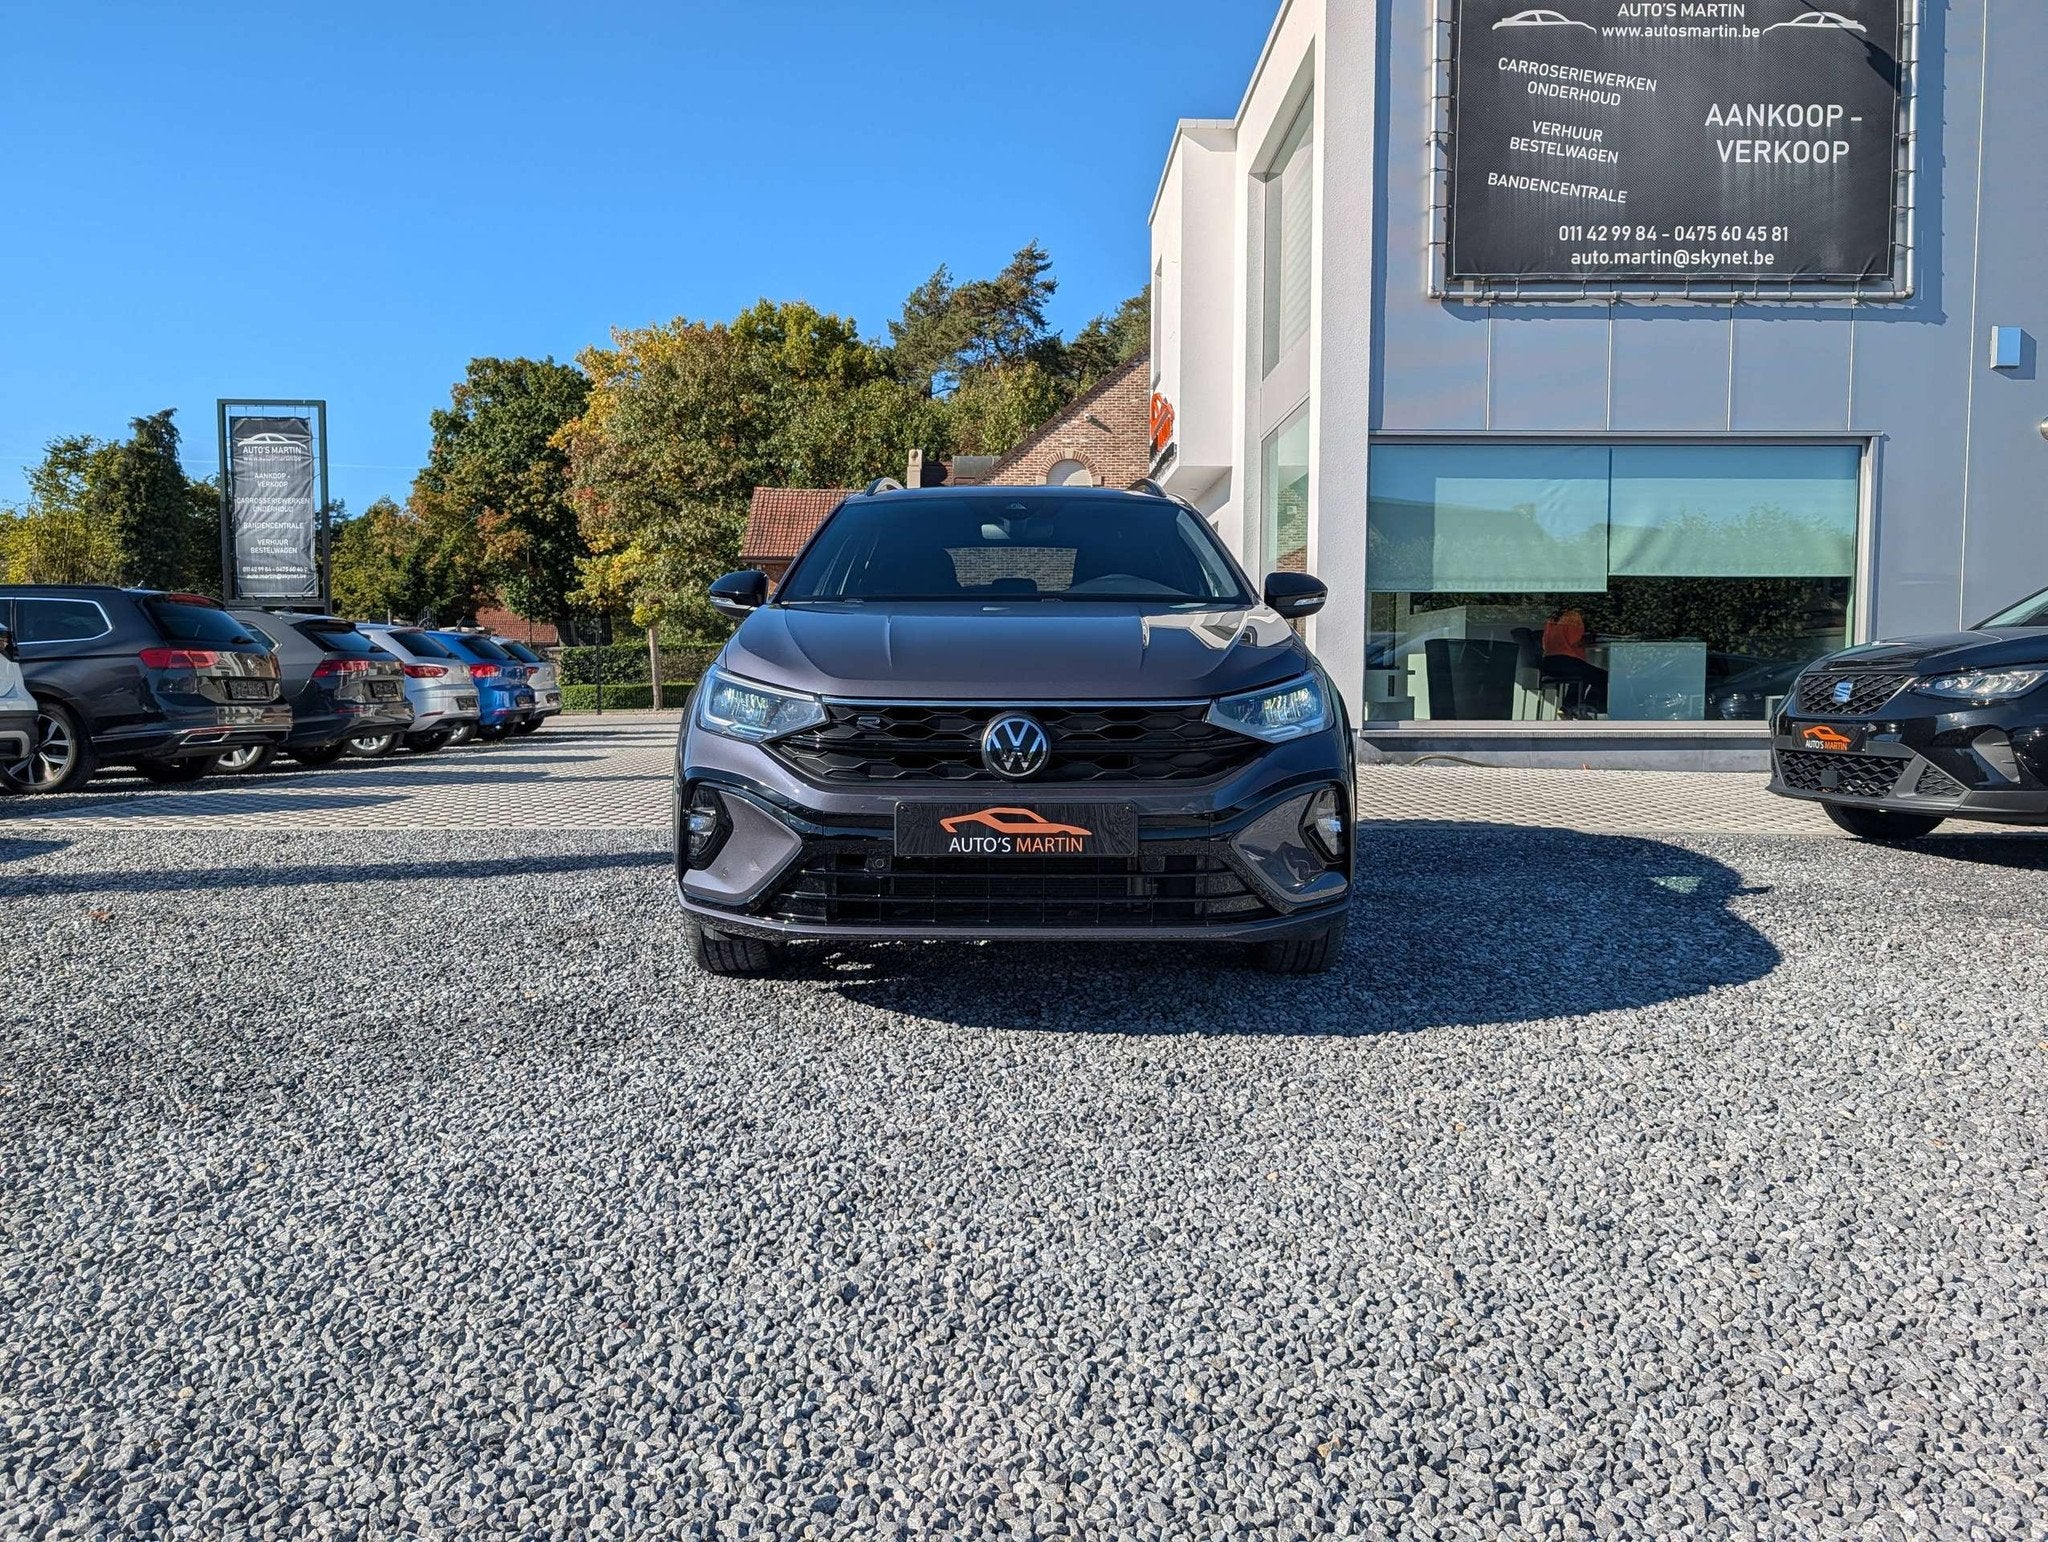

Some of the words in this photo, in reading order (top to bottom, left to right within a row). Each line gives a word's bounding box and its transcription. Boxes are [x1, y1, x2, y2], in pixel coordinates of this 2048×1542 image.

[1617, 3, 1677, 17] AUTO'S
[1680, 3, 1745, 18] MARTIN
[1601, 24, 1761, 38] www.autosmartin.be
[1498, 57, 1657, 93] CARROSERIEWERKEN
[1527, 81, 1621, 106] ONDERHOUD
[1704, 103, 1844, 128] AANKOOP
[1532, 120, 1603, 142] VERHUUR
[1509, 137, 1619, 164] BESTELWAGEN
[1716, 140, 1850, 164] VERKOOP
[1487, 172, 1628, 203] BANDENCENTRALE
[1558, 225, 1582, 241] 011
[1586, 225, 1608, 241] 42
[1611, 225, 1631, 241] 99
[1635, 225, 1657, 241] 84
[1674, 225, 1717, 241] 0475
[1721, 225, 1742, 241] 60
[1745, 226, 1767, 242] 45
[1771, 226, 1788, 242] 81
[1570, 249, 1775, 268] auto.martin@skynet.be
[242, 446, 270, 454] AUTO'S
[271, 446, 302, 454] MARTIN
[257, 480, 289, 488] VERKOOP
[257, 538, 289, 546] VERHUUR
[1805, 739, 1825, 749] AUTO'S
[1825, 740, 1848, 751] MARTIN
[949, 837, 1011, 852] AUTO'S
[1016, 837, 1083, 852] MARTIN
